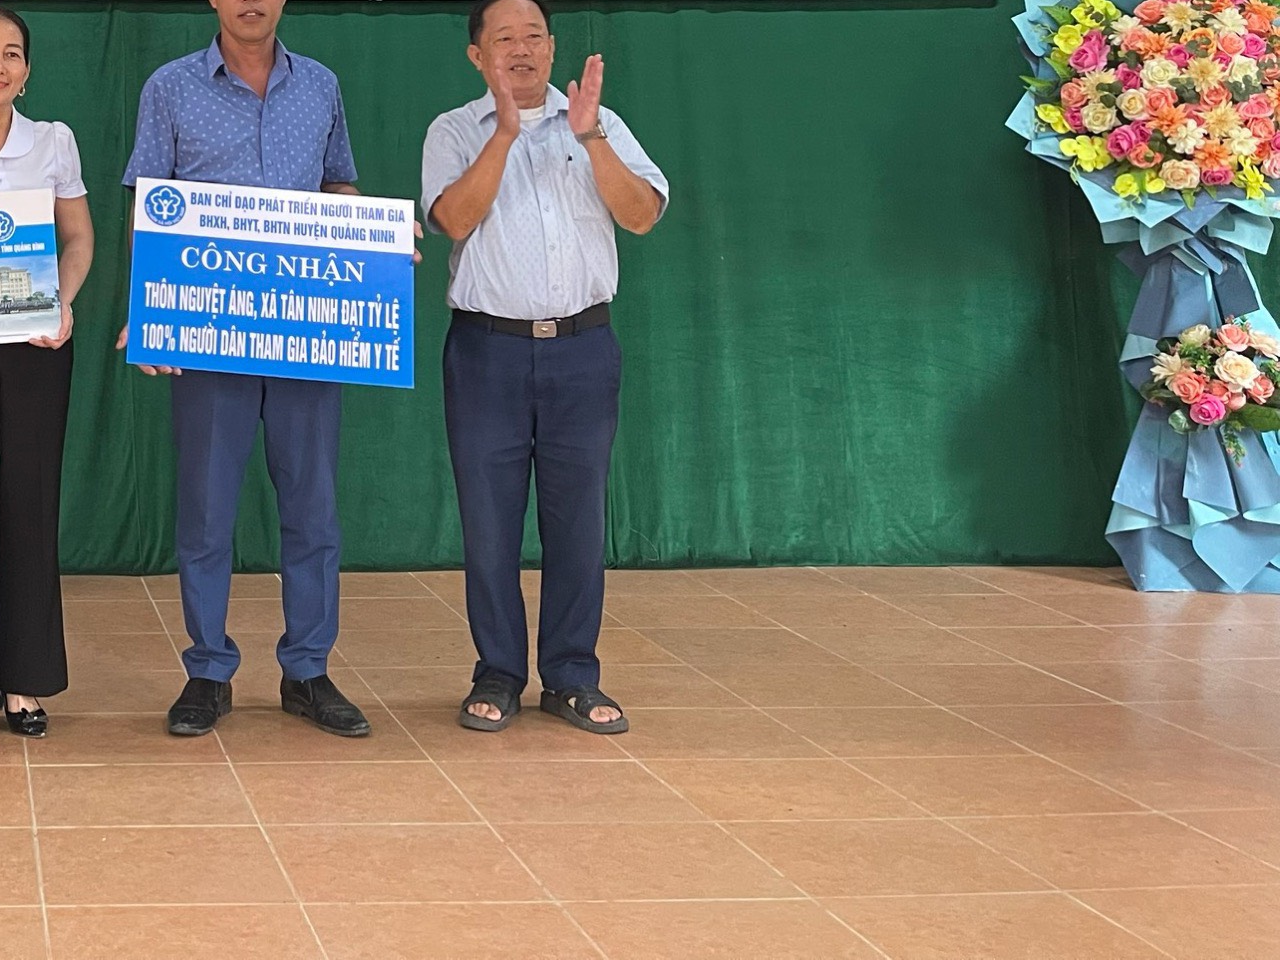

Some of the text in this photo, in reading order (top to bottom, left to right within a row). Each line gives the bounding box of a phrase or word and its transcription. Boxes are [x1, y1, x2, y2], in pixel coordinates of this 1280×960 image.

[190, 192, 212, 207] BAN
[214, 191, 232, 208] CHỈ
[258, 196, 285, 213] PHÁT
[356, 206, 385, 221] THAM
[388, 209, 406, 223] GIA
[200, 214, 230, 231] BHXH,
[233, 217, 260, 234] BHYT,
[263, 220, 291, 235] BHTN
[294, 221, 328, 241] HUYỆN
[331, 222, 366, 241] QUẢNG
[369, 228, 396, 244] NINH
[181, 242, 366, 287] CÔNG NHẬN
[144, 277, 400, 335] THÔN NGUYỆT ÁNG, XÃ TÂN NINH ĐẠT TỶ LỆ
[142, 322, 401, 371] 100% NGƯỜI DÂN THAM GIA BẢO HIỂM Y TẾ
